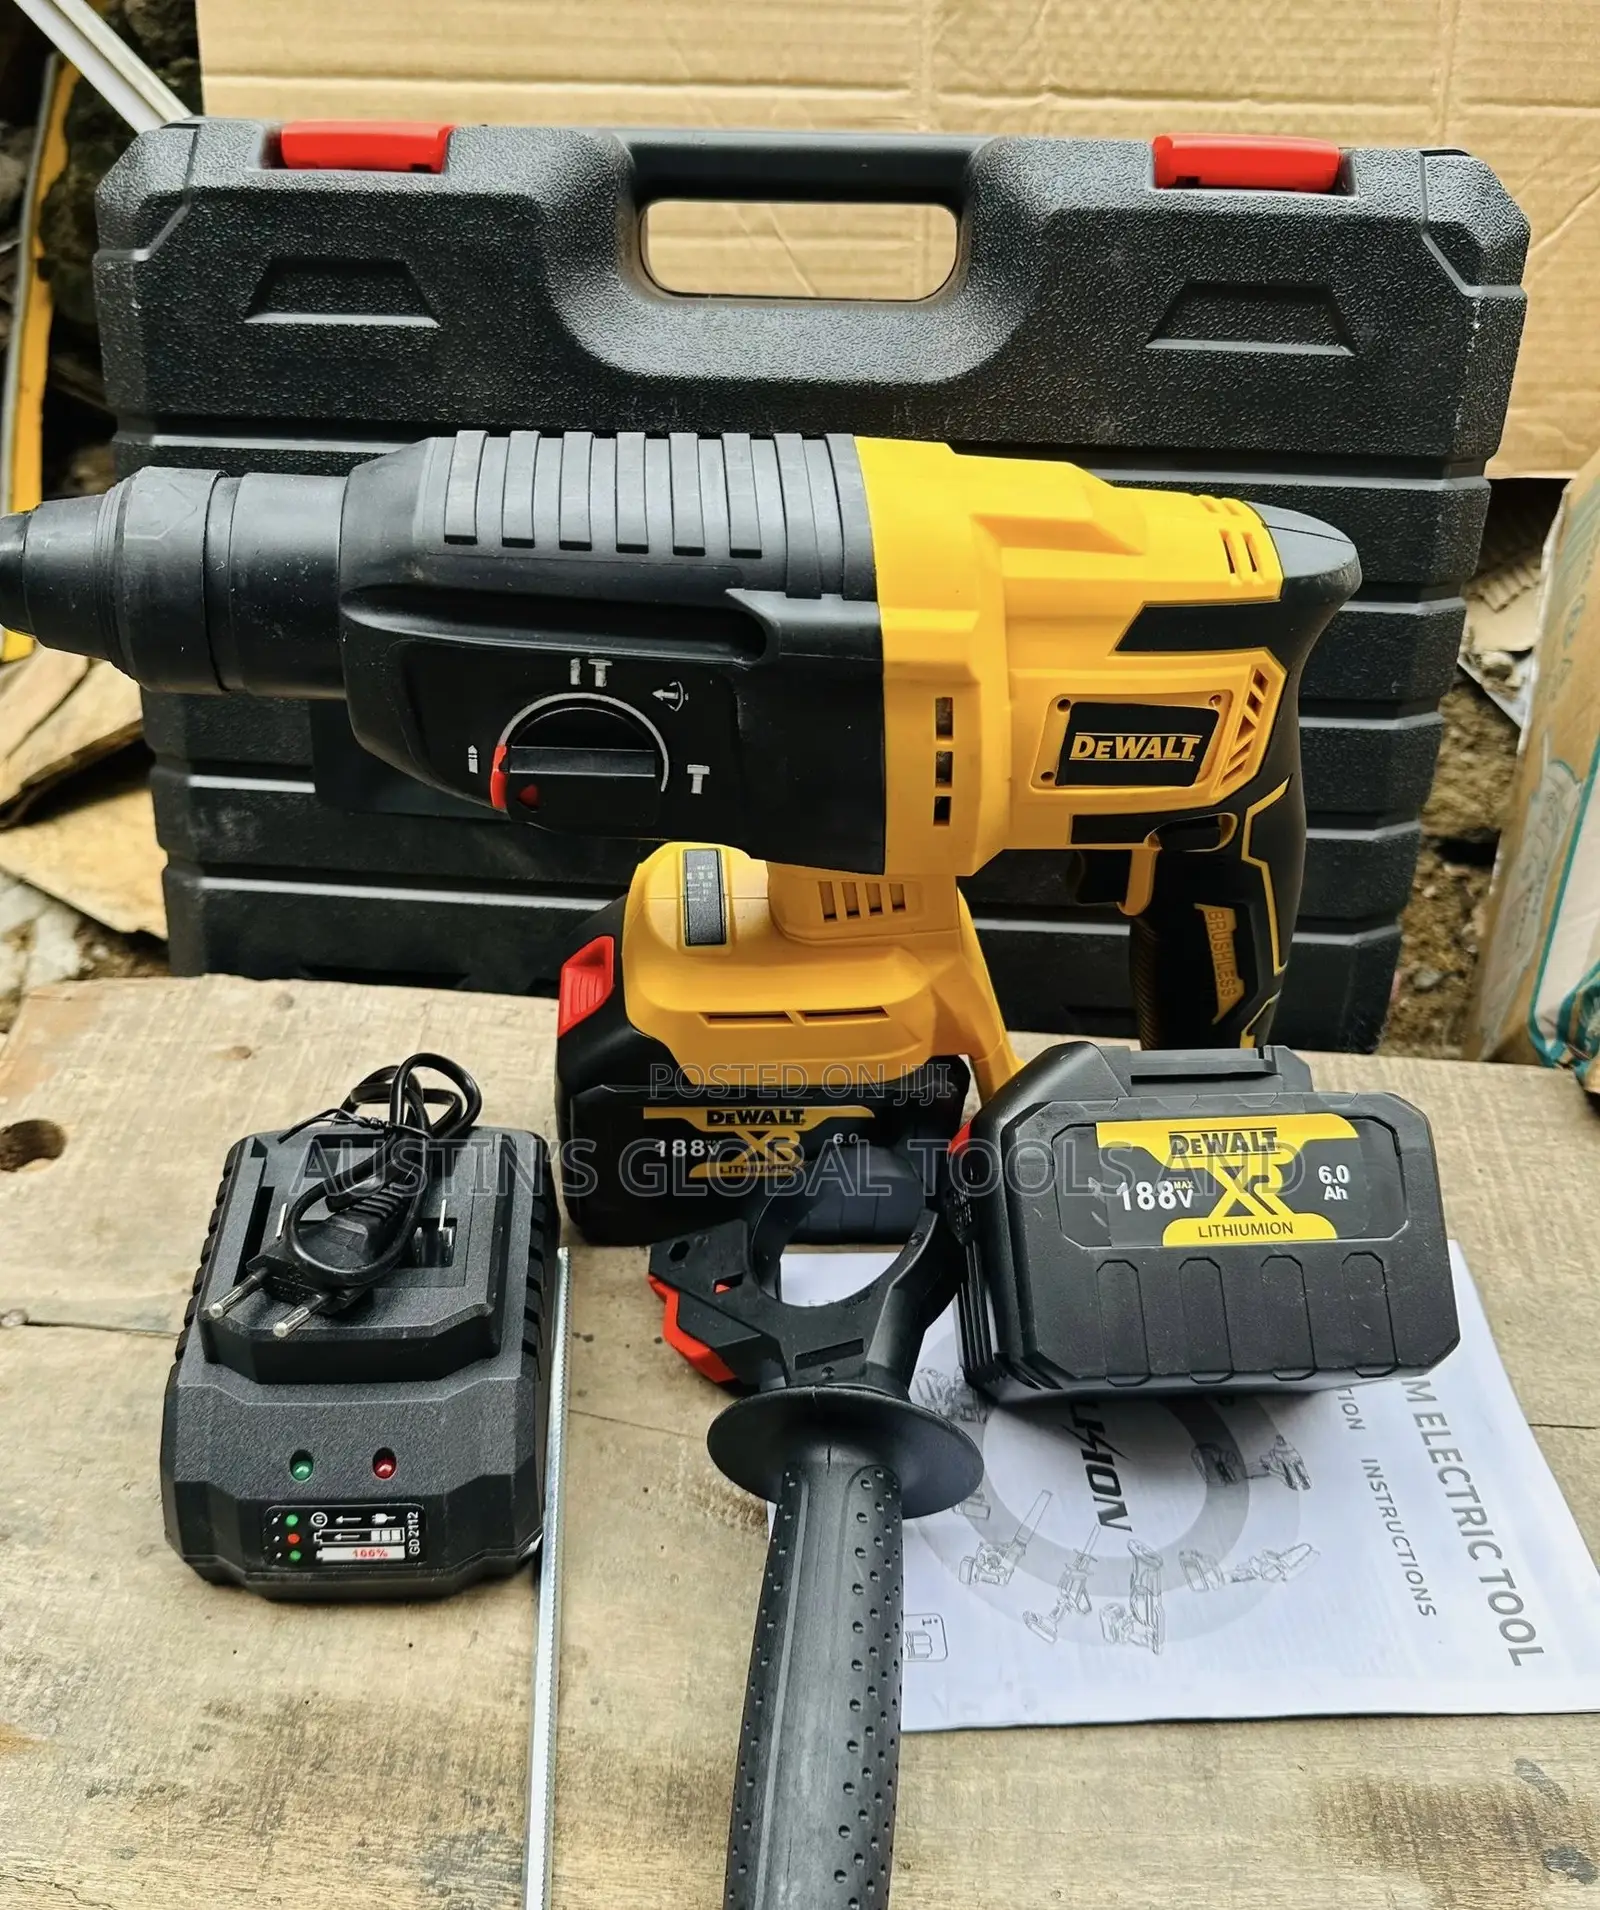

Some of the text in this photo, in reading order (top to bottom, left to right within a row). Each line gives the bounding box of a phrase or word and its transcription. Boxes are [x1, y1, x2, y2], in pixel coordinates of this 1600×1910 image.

[1207, 911, 1237, 997] BRUSHLESS
[833, 1133, 859, 1144] 6.0
[1173, 1180, 1194, 1190] MAX
[1318, 1164, 1350, 1185] 6.0
[1323, 1185, 1348, 1201] Ah
[1198, 1221, 1294, 1239] LITHIUMION
[1335, 1387, 1437, 1617] TION INSTRUCTIONS
[406, 1511, 421, 1556] GD 2112
[1412, 1411, 1503, 1561] ELECTRIC
[1478, 1567, 1545, 1667] TOOL
